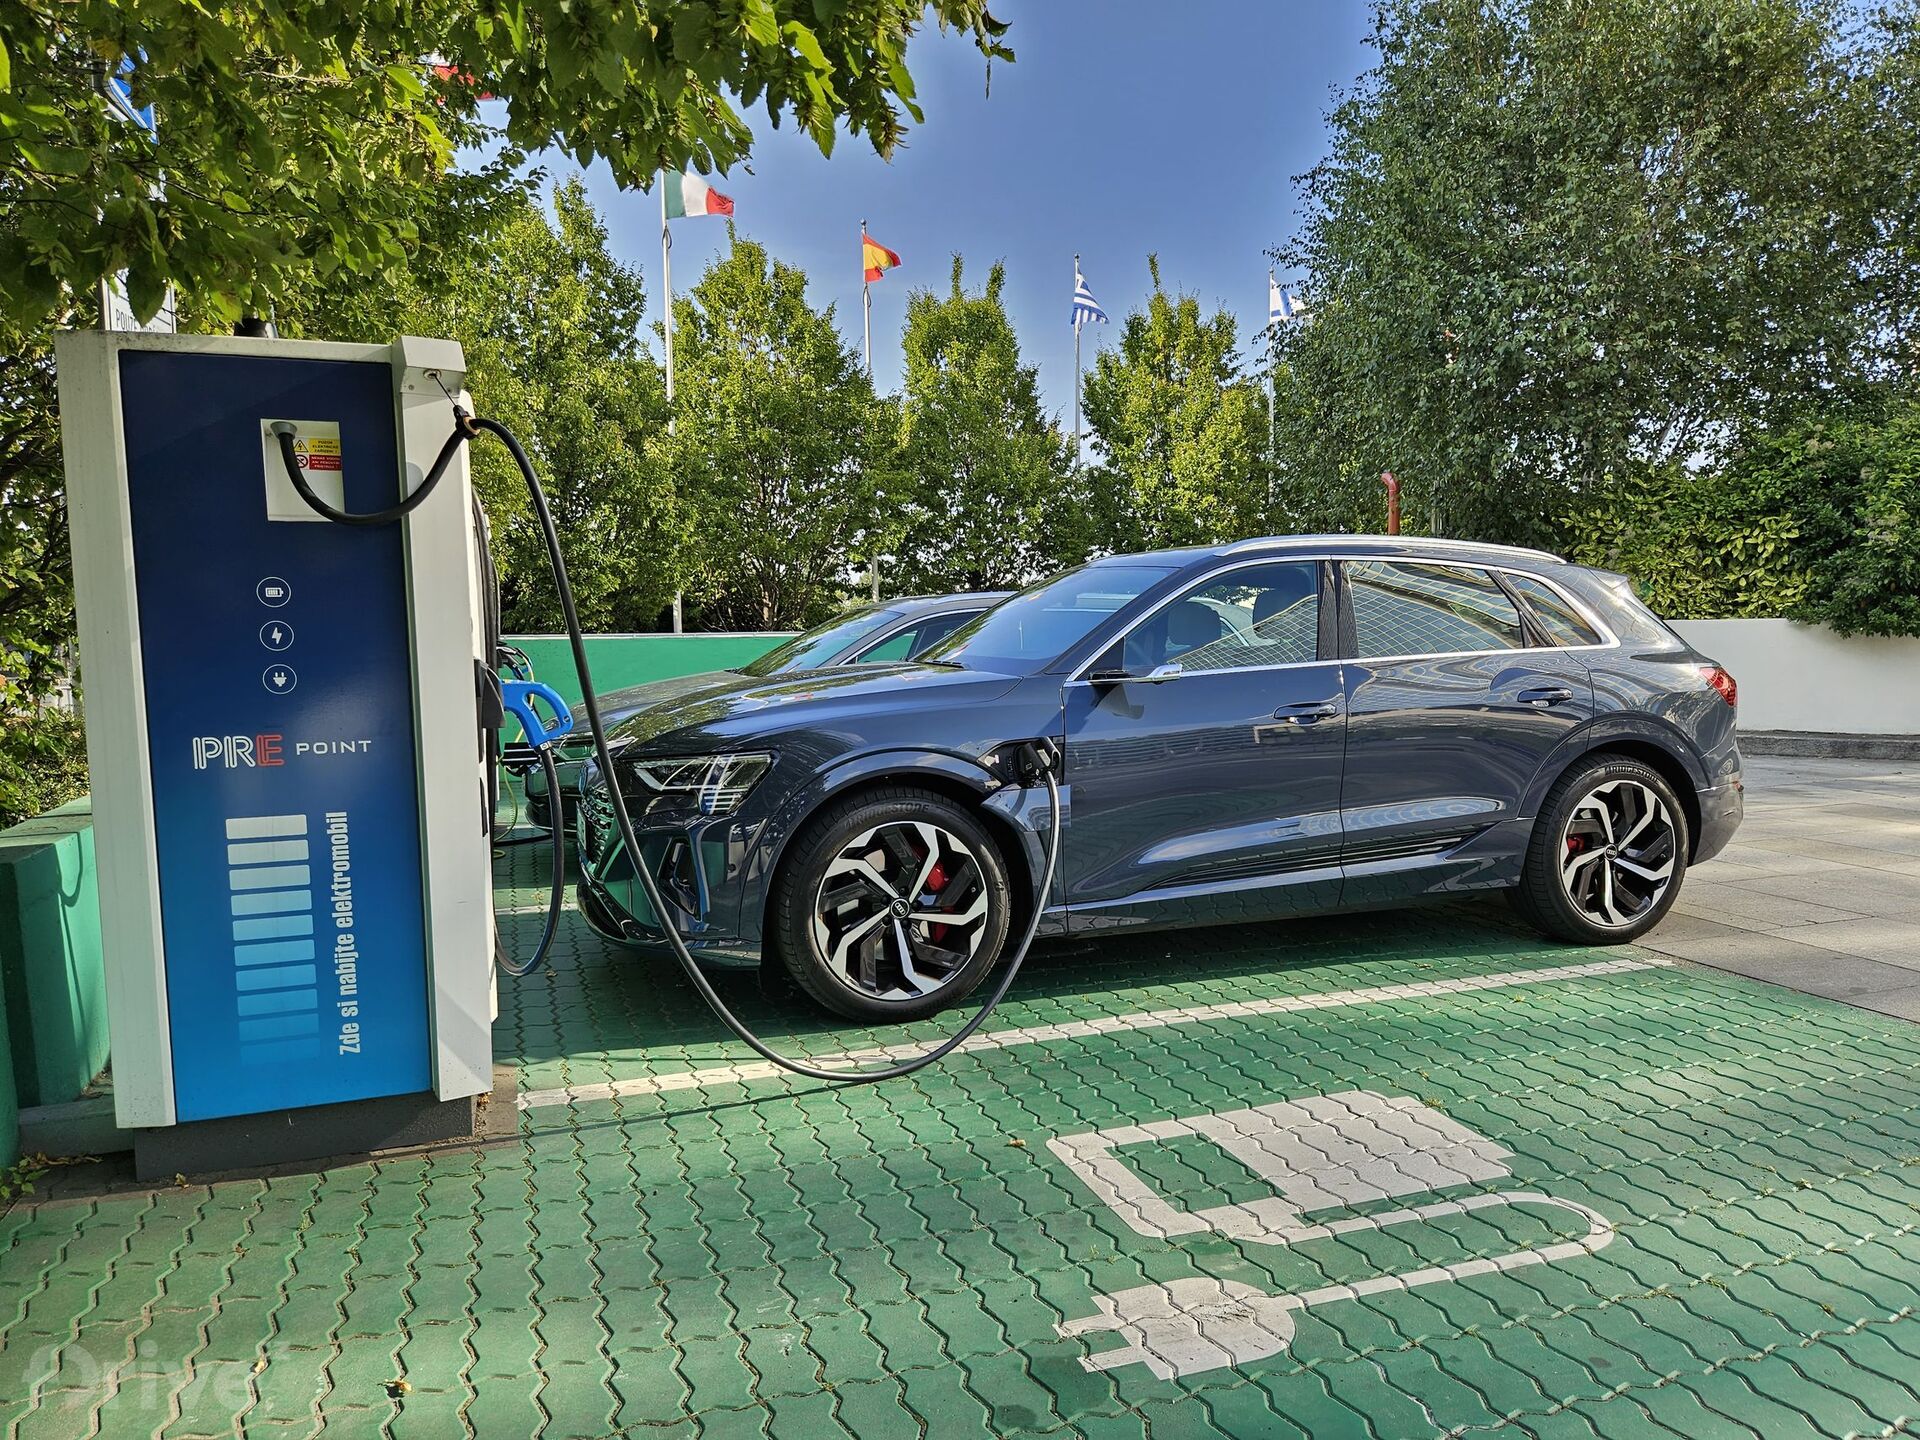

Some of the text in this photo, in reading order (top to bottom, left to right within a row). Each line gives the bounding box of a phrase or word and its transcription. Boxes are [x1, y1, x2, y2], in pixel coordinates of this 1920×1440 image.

[192, 734, 372, 770] PRE POINT
[325, 811, 361, 1055] Zde si nabijte elektromobil
